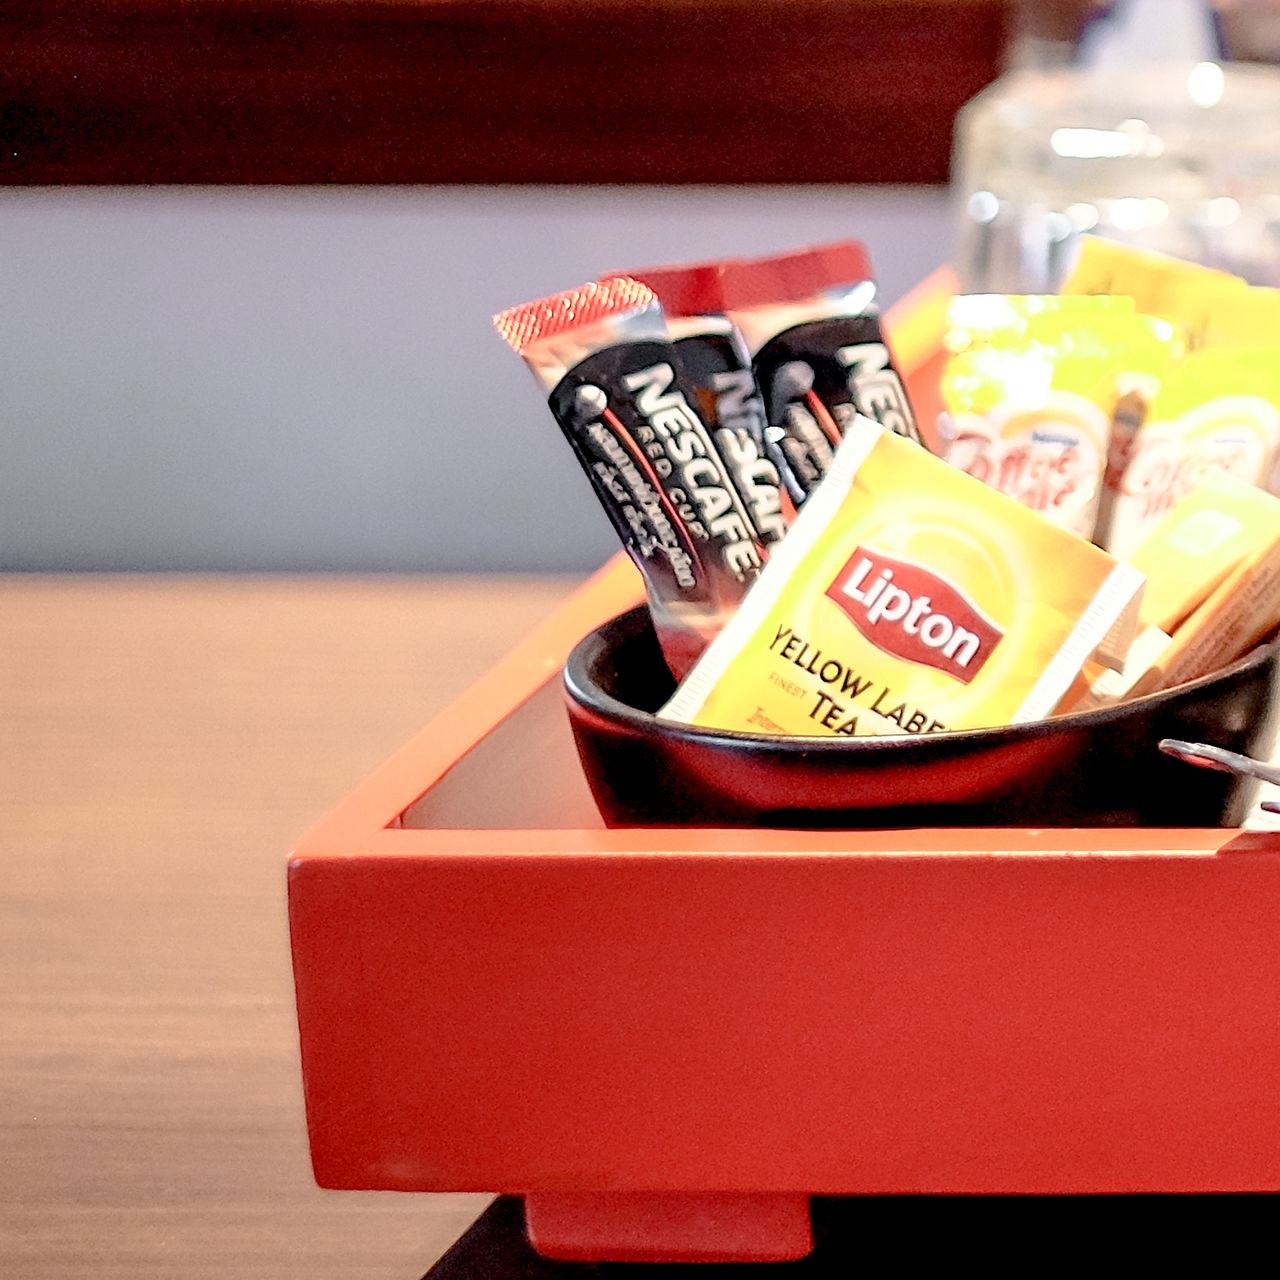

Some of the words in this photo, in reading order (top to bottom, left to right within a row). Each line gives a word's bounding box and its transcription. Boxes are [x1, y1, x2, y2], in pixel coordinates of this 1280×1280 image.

[637, 425, 673, 479] RED
[669, 487, 709, 540] CUP
[841, 556, 981, 668] Lipton
[768, 624, 874, 700] YELLOW
[870, 687, 950, 733] LABE
[809, 689, 859, 736] TEA
